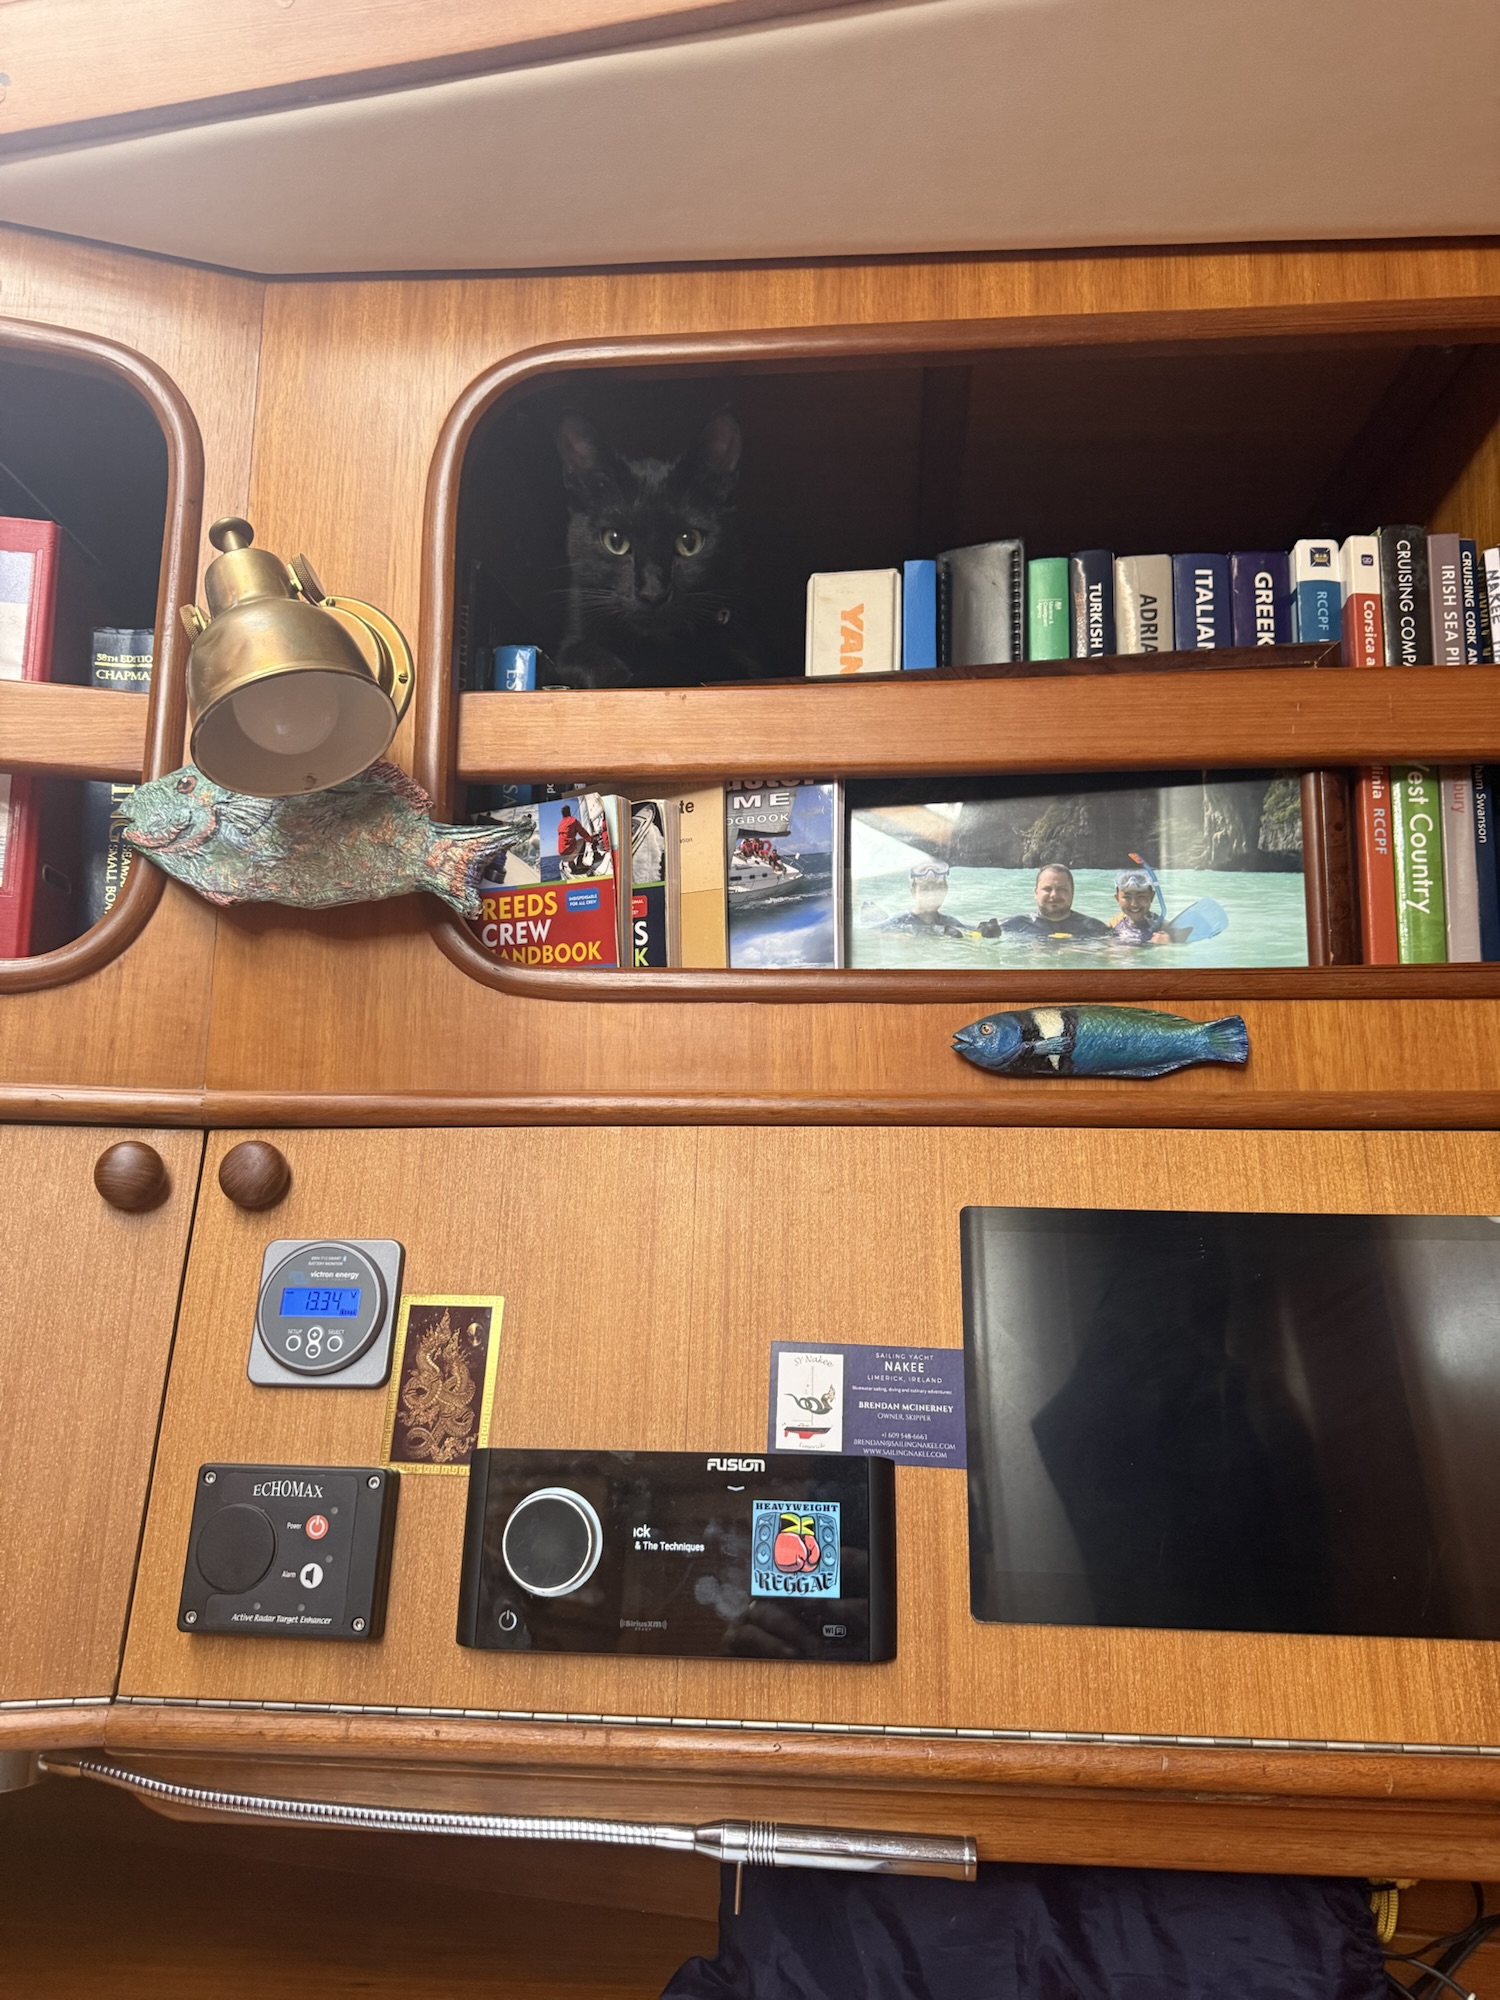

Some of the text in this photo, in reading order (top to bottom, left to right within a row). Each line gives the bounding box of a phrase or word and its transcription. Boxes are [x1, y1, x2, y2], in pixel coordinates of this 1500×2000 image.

[1396, 540, 1415, 612] CRUISING
[1441, 565, 1457, 605] IRISH
[1462, 551, 1475, 607] CRUISING
[1089, 582, 1104, 649] TURKISH
[1254, 572, 1276, 646] GREEK
[1317, 591, 1330, 632] RCCPF
[1363, 600, 1378, 654] Corsica
[1444, 612, 1459, 642] SEA
[1465, 611, 1477, 644] CORK
[95, 669, 152, 680] CHAPMA
[1374, 807, 1388, 855] RCCPF
[1476, 792, 1487, 844] Swanson
[1406, 813, 1434, 914] Country
[103, 843, 119, 915] SMALL BOA
[483, 892, 558, 921] REEDS
[482, 919, 552, 948] CREW
[491, 940, 602, 966] ANDBOOK
[310, 1270, 334, 1278] victron
[335, 1272, 360, 1280] energy
[305, 1291, 342, 1311] 13.34
[875, 1352, 906, 1360] SAILING
[884, 1361, 925, 1373] NAKEE
[867, 1374, 943, 1384] LIMERICK, IRELAND
[858, 1400, 954, 1413] BRENDAN MCINERNEY
[252, 1480, 324, 1498] ECHOMAX
[755, 1502, 839, 1512] HEAVYWEIGHT
[286, 1521, 302, 1530] Power
[643, 1541, 658, 1550] The
[660, 1542, 705, 1553] Techniques
[281, 1570, 297, 1579] Alarm
[755, 1570, 836, 1595] REGGAE
[231, 1613, 332, 1625] Active Radar Target Enhancer
